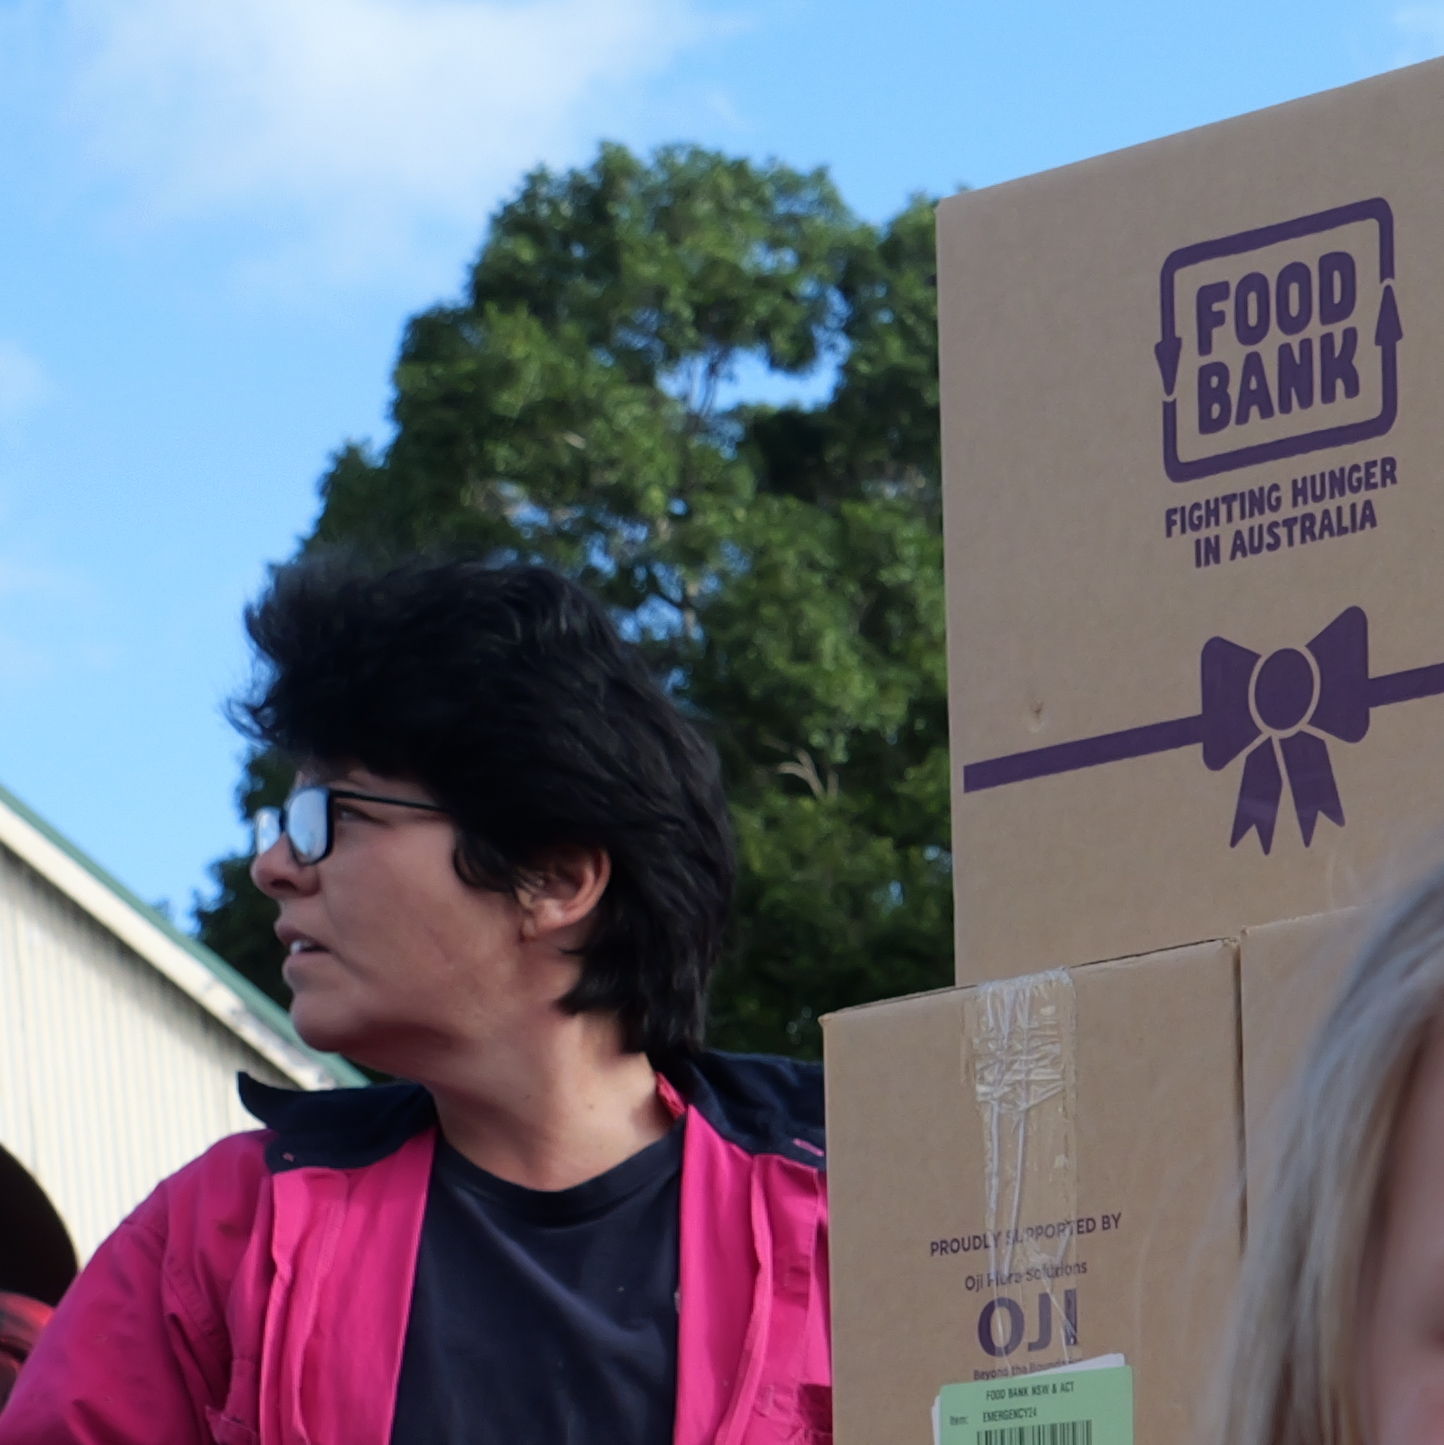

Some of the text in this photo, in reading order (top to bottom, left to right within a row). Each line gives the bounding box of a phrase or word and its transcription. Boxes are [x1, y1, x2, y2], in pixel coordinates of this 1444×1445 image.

[1197, 251, 1357, 354] FOOD
[1198, 322, 1360, 436] BANK
[1164, 456, 1398, 538] FIGHTING HUNGER
[1194, 499, 1378, 568] IN AUSTRALIA
[977, 1289, 1078, 1357] OJI
